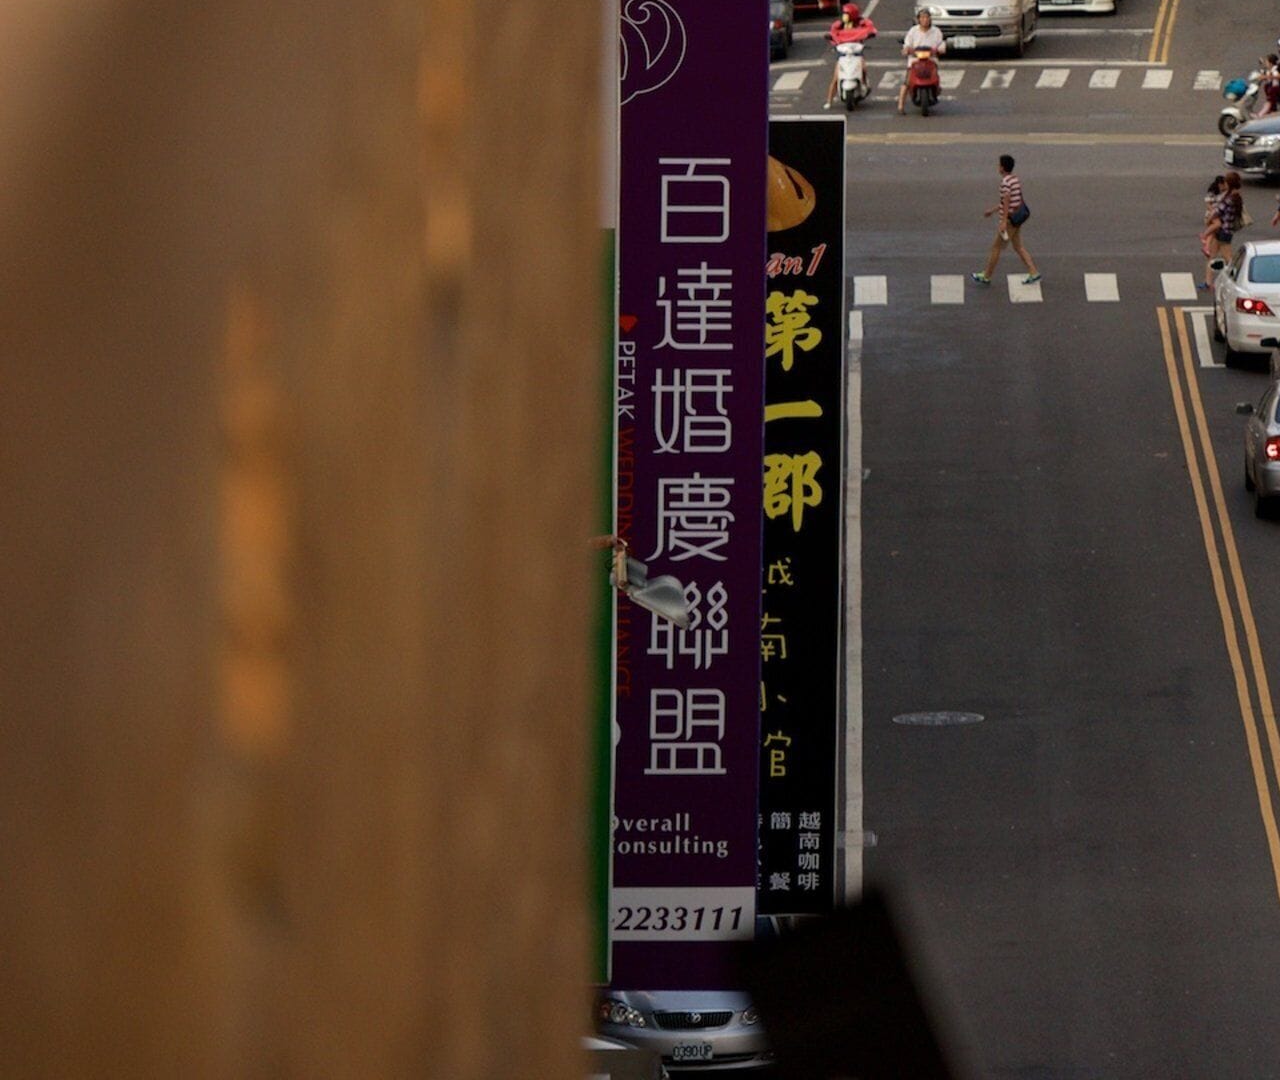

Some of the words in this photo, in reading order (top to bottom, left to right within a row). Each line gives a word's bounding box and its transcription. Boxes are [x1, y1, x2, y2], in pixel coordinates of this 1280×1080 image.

[617, 427, 635, 551] WEDDIN
[644, 157, 736, 775] 百達婚慶聯盟
[797, 810, 822, 892] 越南咖啡
[614, 906, 744, 932] 2233111
